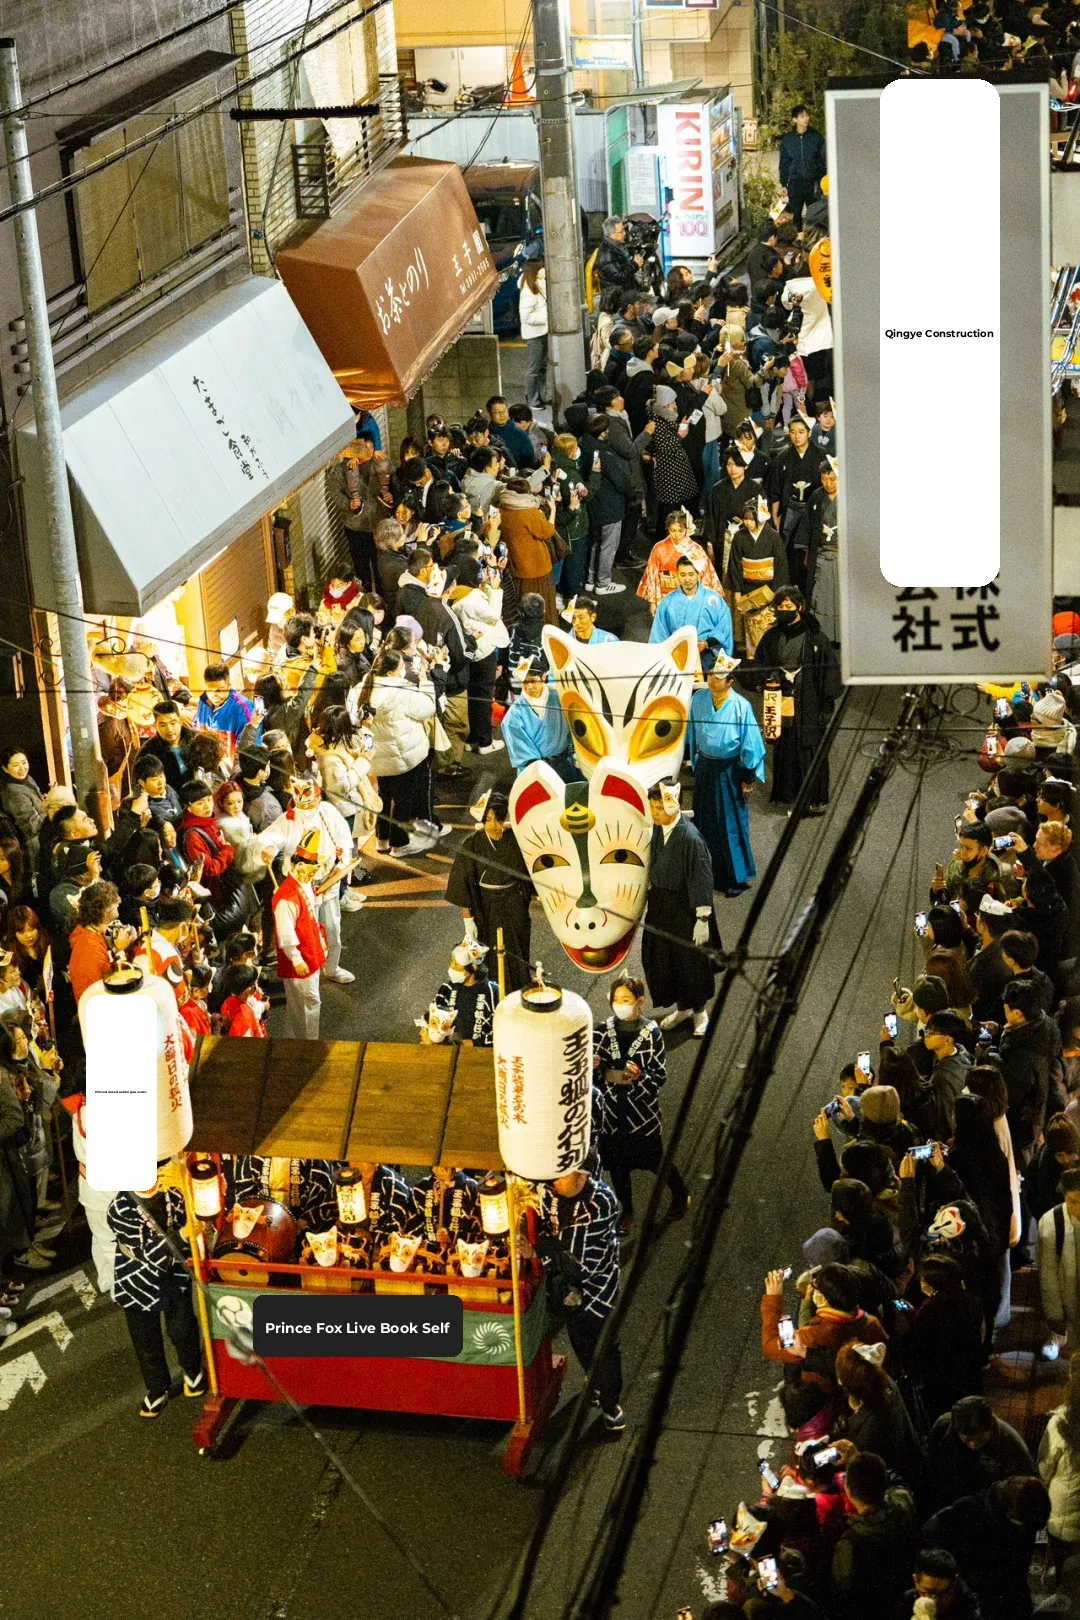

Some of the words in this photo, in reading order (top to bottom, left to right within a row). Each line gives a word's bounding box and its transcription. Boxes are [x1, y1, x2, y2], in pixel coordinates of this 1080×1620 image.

[675, 112, 705, 211] KIRIN
[375, 247, 429, 336] お茶とのり
[765, 693, 777, 702] JR
[765, 705, 777, 738] 王子駅
[555, 1024, 589, 1173] 王子狐の行列
